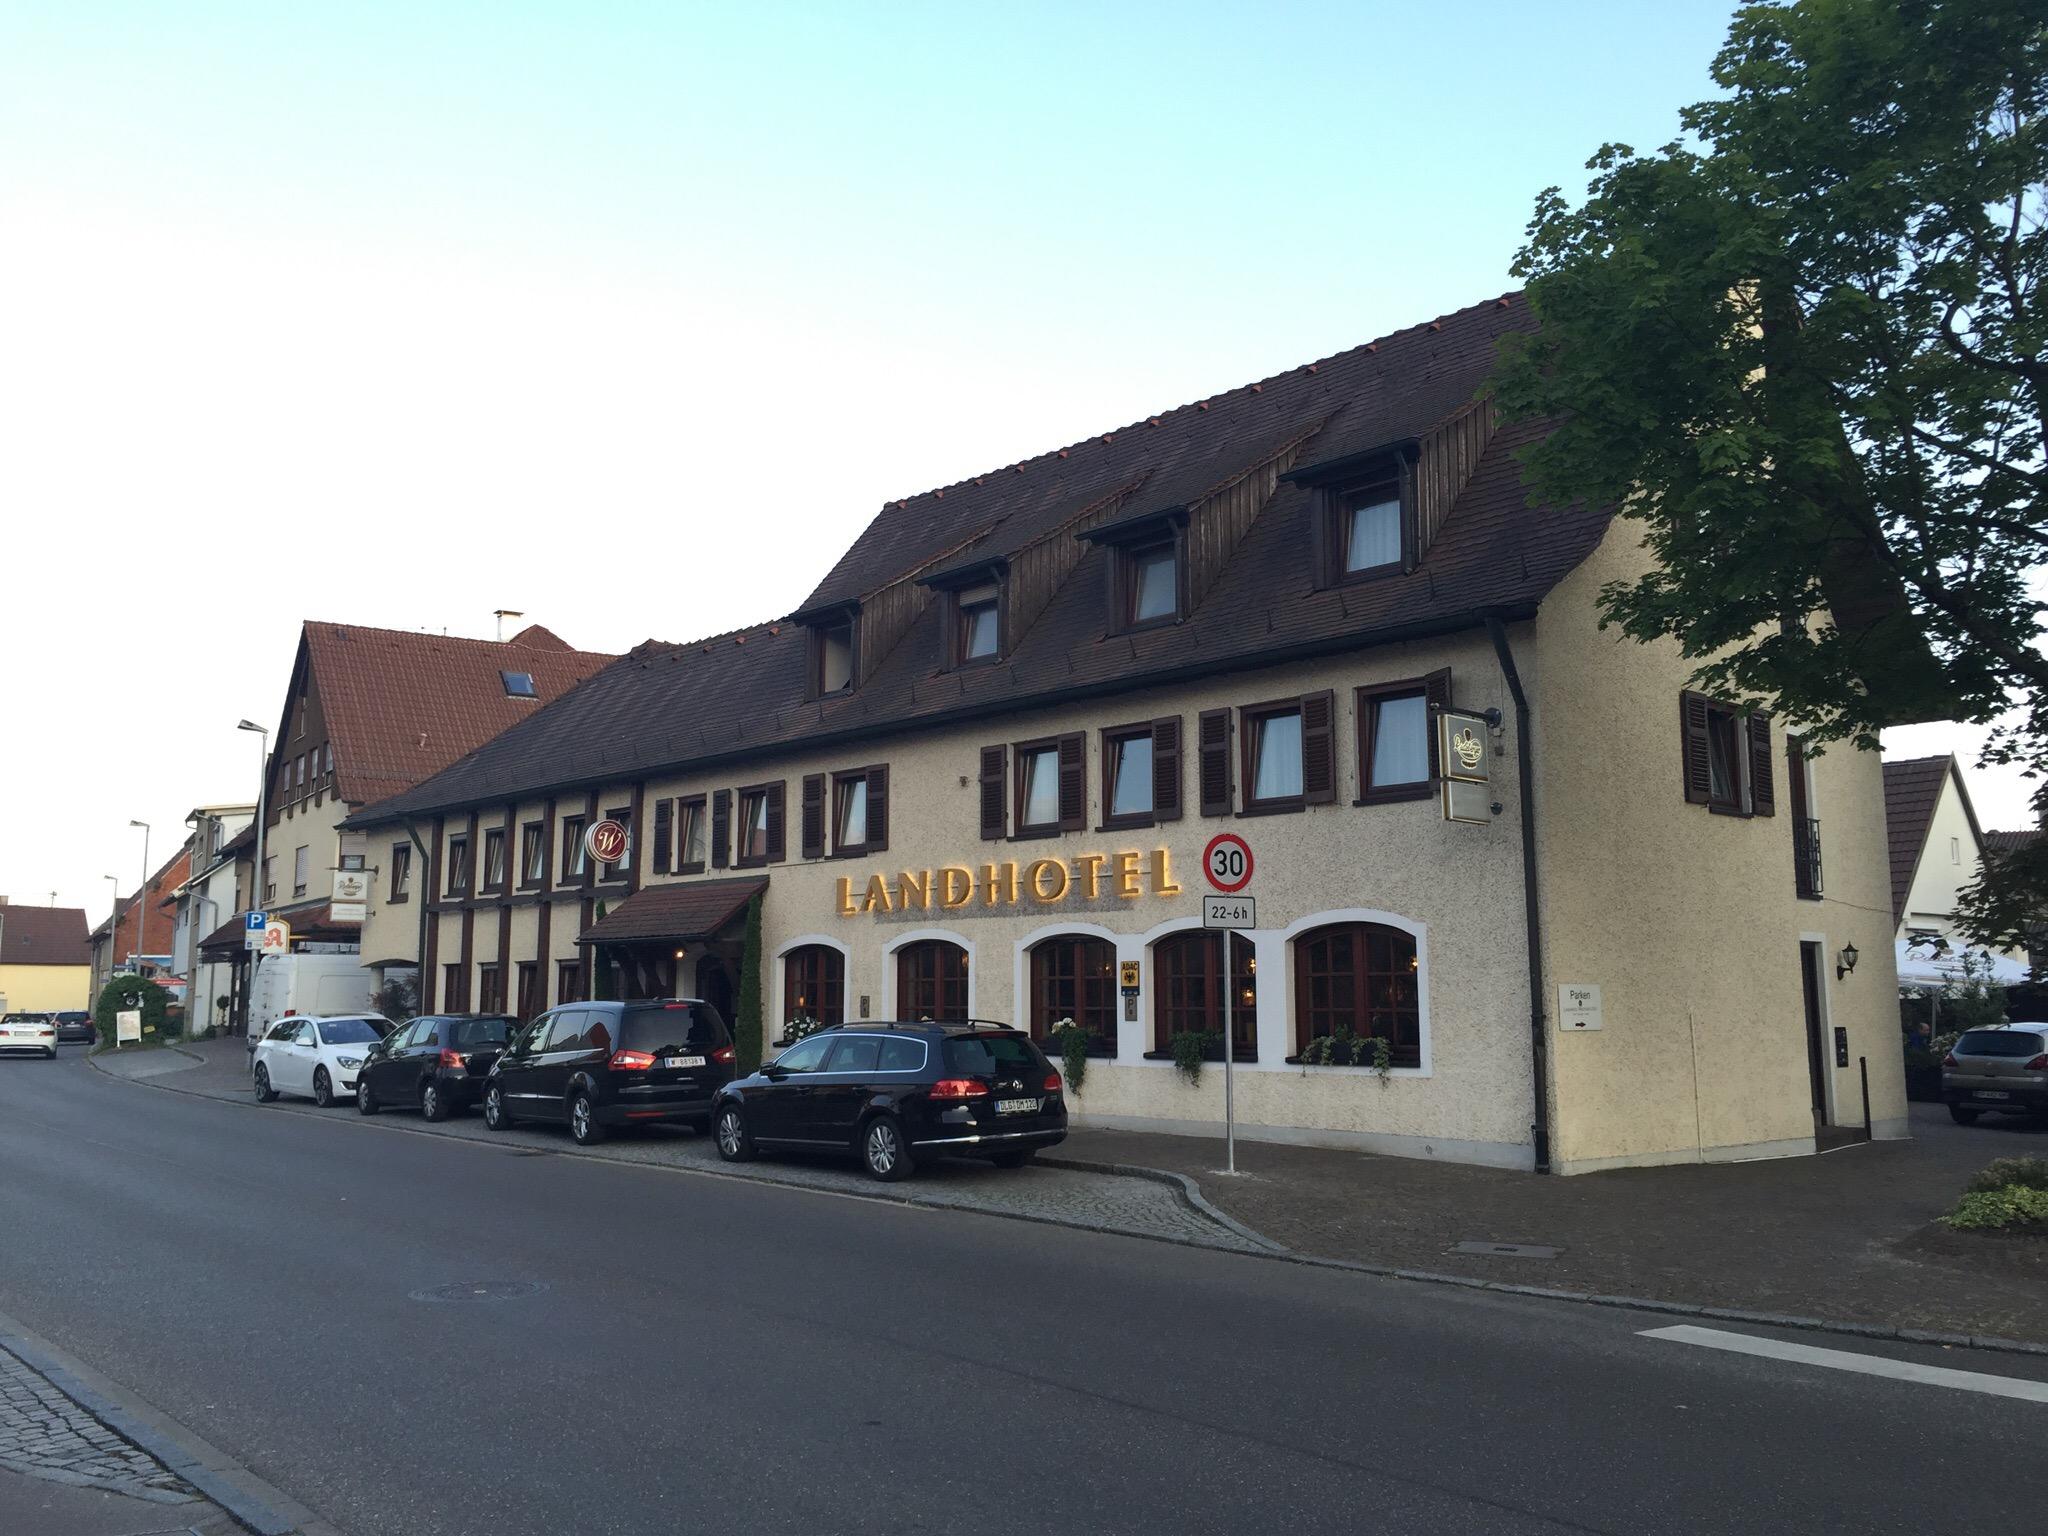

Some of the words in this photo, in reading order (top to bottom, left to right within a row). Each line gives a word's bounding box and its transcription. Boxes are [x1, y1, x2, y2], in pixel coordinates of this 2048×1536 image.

[598, 831, 622, 852] W
[1213, 849, 1243, 876] 30
[835, 850, 1179, 914] LANDHOTEL
[250, 914, 262, 928] P
[1122, 962, 1138, 970] ADAC
[1570, 990, 1591, 1000] Parken
